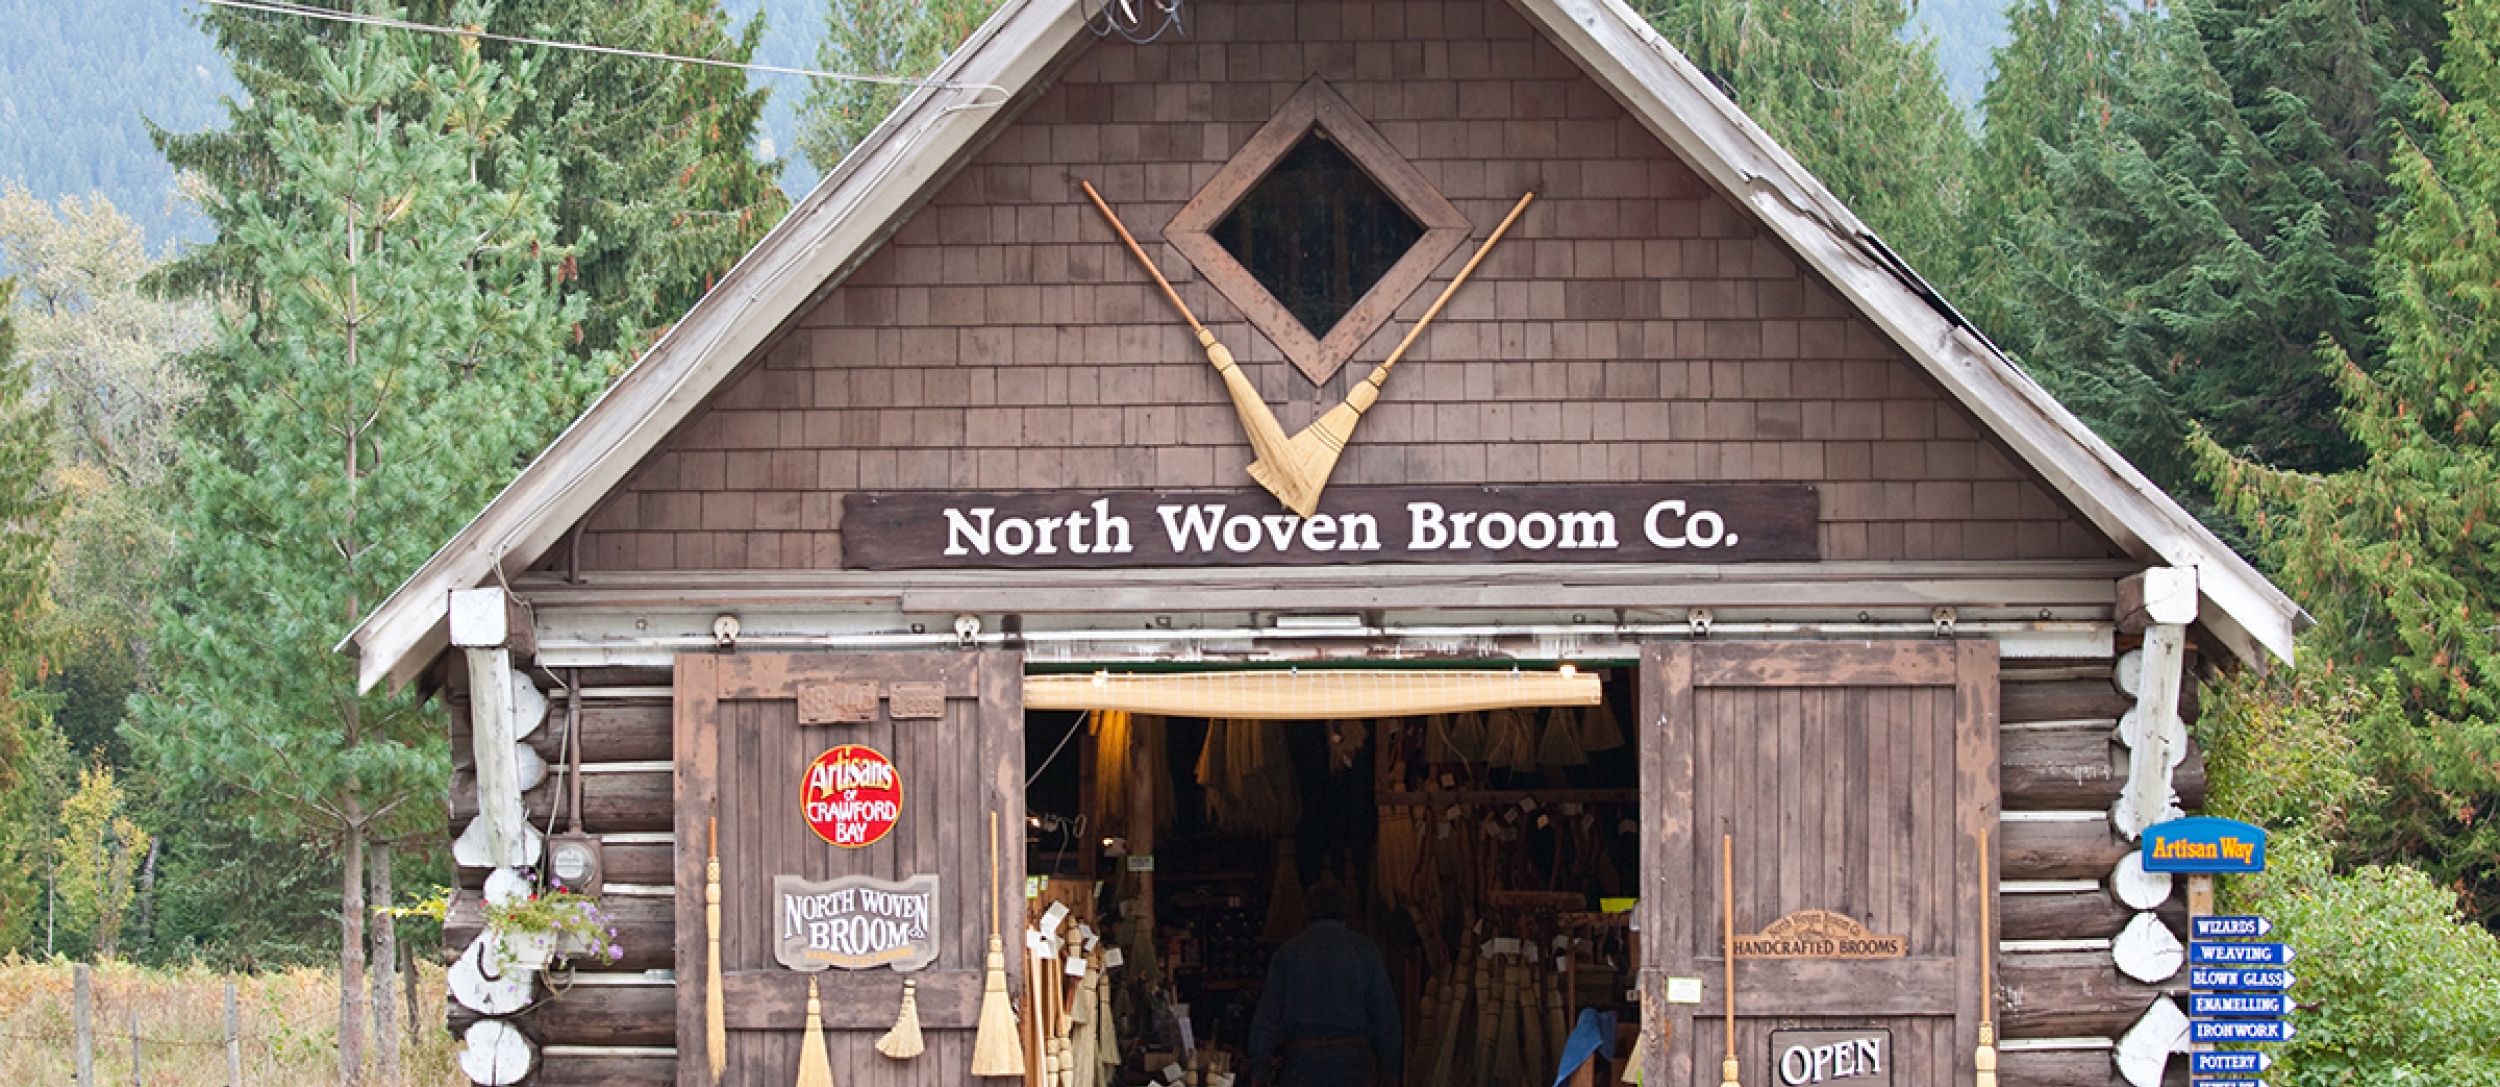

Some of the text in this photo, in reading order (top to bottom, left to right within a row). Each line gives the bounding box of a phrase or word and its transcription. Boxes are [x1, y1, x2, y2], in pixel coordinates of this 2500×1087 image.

[943, 498, 1738, 555] North Woven Broom Co.
[807, 747, 893, 799] Artisans
[807, 801, 897, 822] CRAWFORD
[836, 822, 867, 843] BAY
[2152, 836, 2254, 865] Artisan Way
[783, 887, 930, 939] NORTH WOVEN
[809, 914, 909, 955] BROOM
[2197, 920, 2257, 935] WIZARDS
[1733, 939, 1899, 955] HANDCRAFTED BROOMS
[2201, 945, 2273, 961] WEAVING
[2193, 970, 2284, 987] BLOWN GLASS
[2195, 997, 2280, 1012] ENAMELLING
[2197, 1023, 2279, 1038] IRONWORK
[1780, 1037, 1882, 1085] OPEN
[2199, 1055, 2257, 1070] POTTERY
